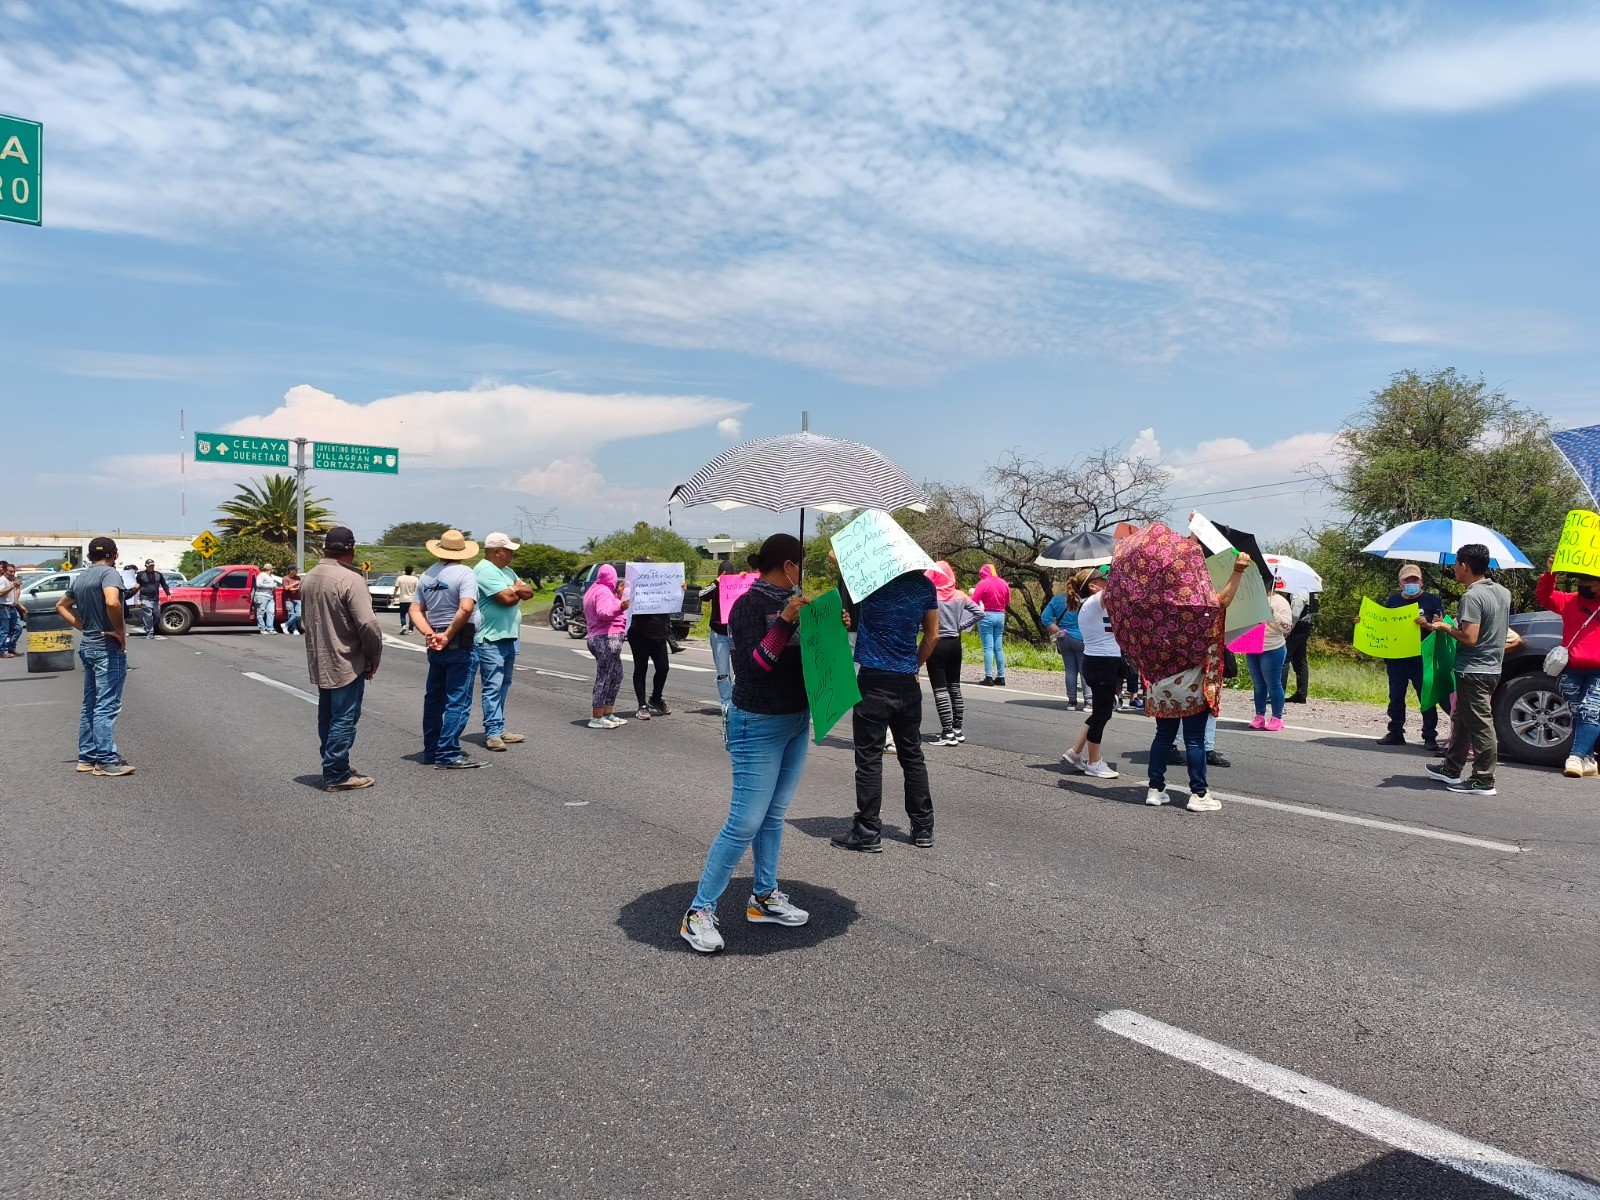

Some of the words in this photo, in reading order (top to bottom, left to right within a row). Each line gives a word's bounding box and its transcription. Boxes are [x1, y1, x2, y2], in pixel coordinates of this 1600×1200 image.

[0, 175, 29, 204] O
[233, 439, 286, 451] CELAYA
[233, 450, 287, 463] QUERETARO
[351, 447, 370, 455] ROSAS
[316, 452, 370, 463] VILLAGRAN
[316, 460, 370, 470] CORTAZAR
